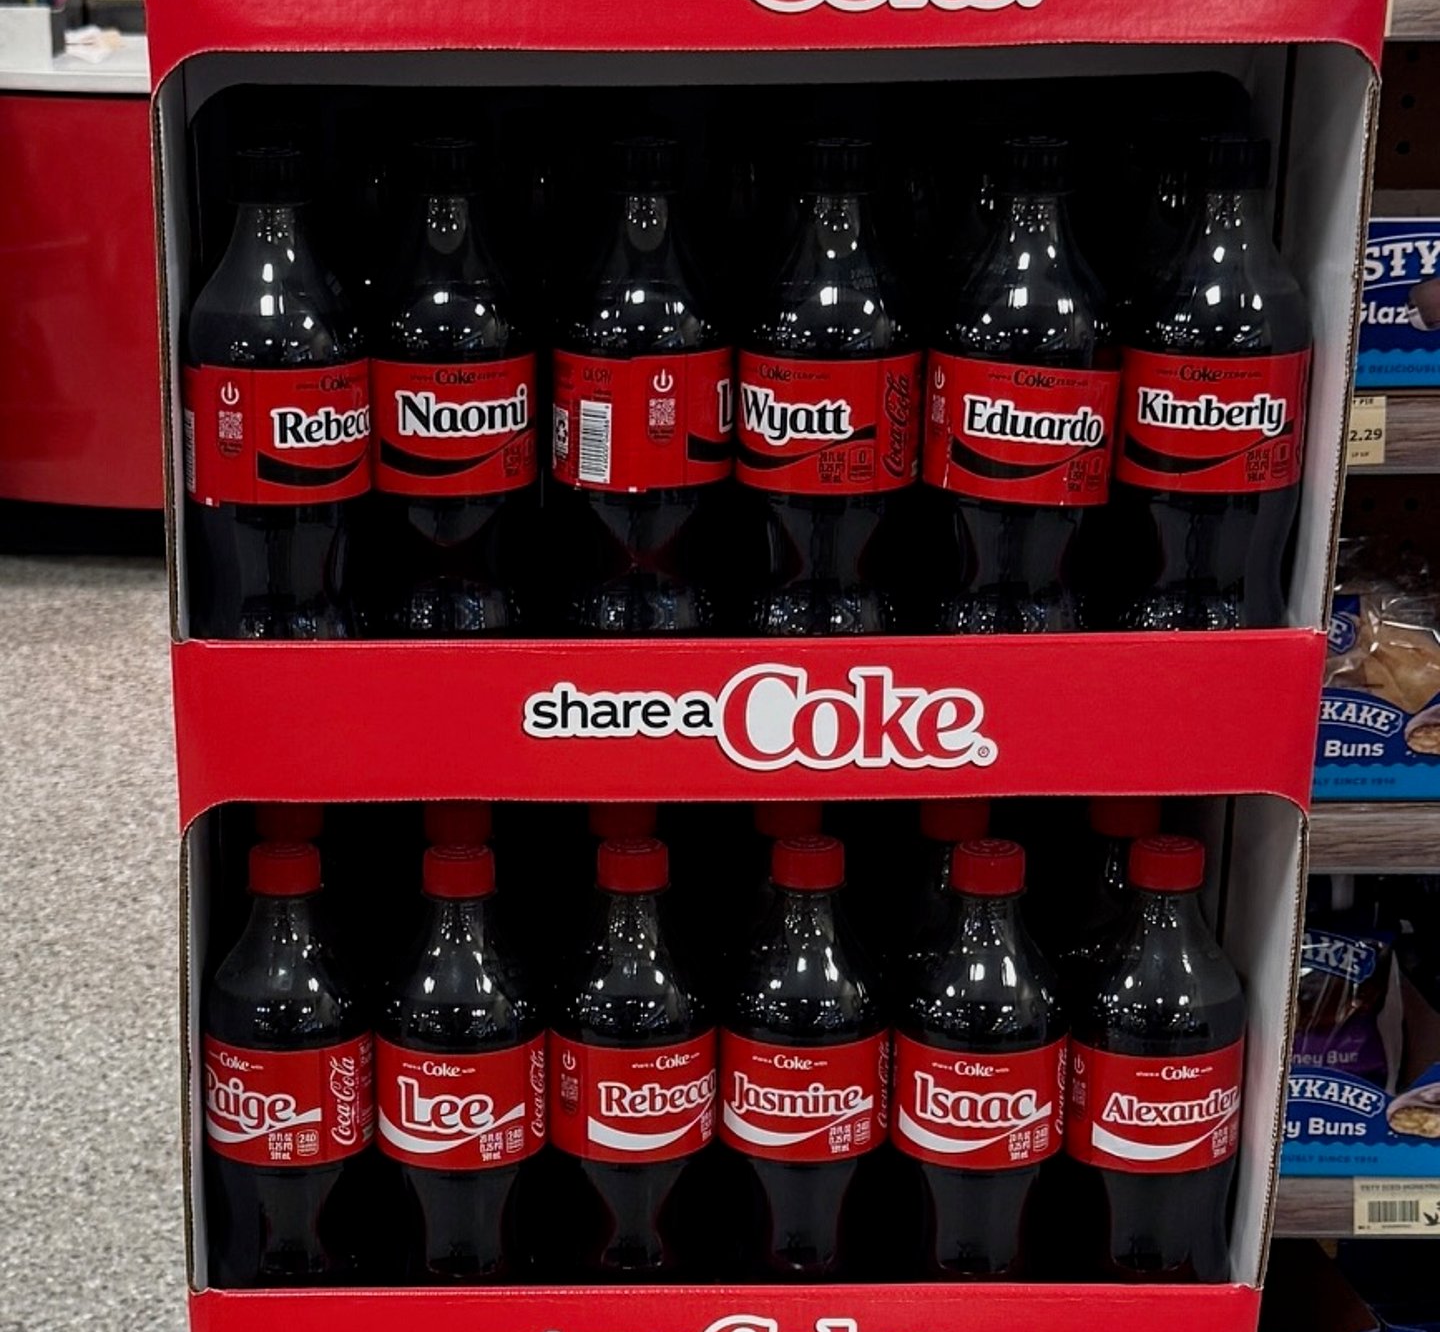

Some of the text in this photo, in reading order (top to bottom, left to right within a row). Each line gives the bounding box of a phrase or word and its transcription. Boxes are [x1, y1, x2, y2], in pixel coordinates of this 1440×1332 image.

[435, 368, 477, 386] Coke
[759, 363, 792, 381] Coke
[1013, 369, 1056, 389] Coke
[1179, 364, 1222, 383] Coke
[400, 385, 527, 435] Naomi
[742, 384, 852, 442] Wyatt
[1140, 389, 1285, 435] Kimberly
[966, 398, 1102, 445] Eduardo
[531, 690, 672, 731] share
[682, 698, 714, 731] a
[1323, 739, 1385, 758] Buns
[219, 1051, 251, 1072] Coke
[422, 1060, 462, 1078] Coke
[656, 1053, 690, 1071] Coke
[773, 1054, 813, 1071] Coke
[954, 1060, 995, 1078] Coke
[1161, 1066, 1200, 1081] Coke
[735, 1071, 862, 1115] Jasmine
[916, 1073, 1034, 1124] Isaac
[401, 1078, 491, 1130] Lee
[1308, 1117, 1367, 1136] Buns
